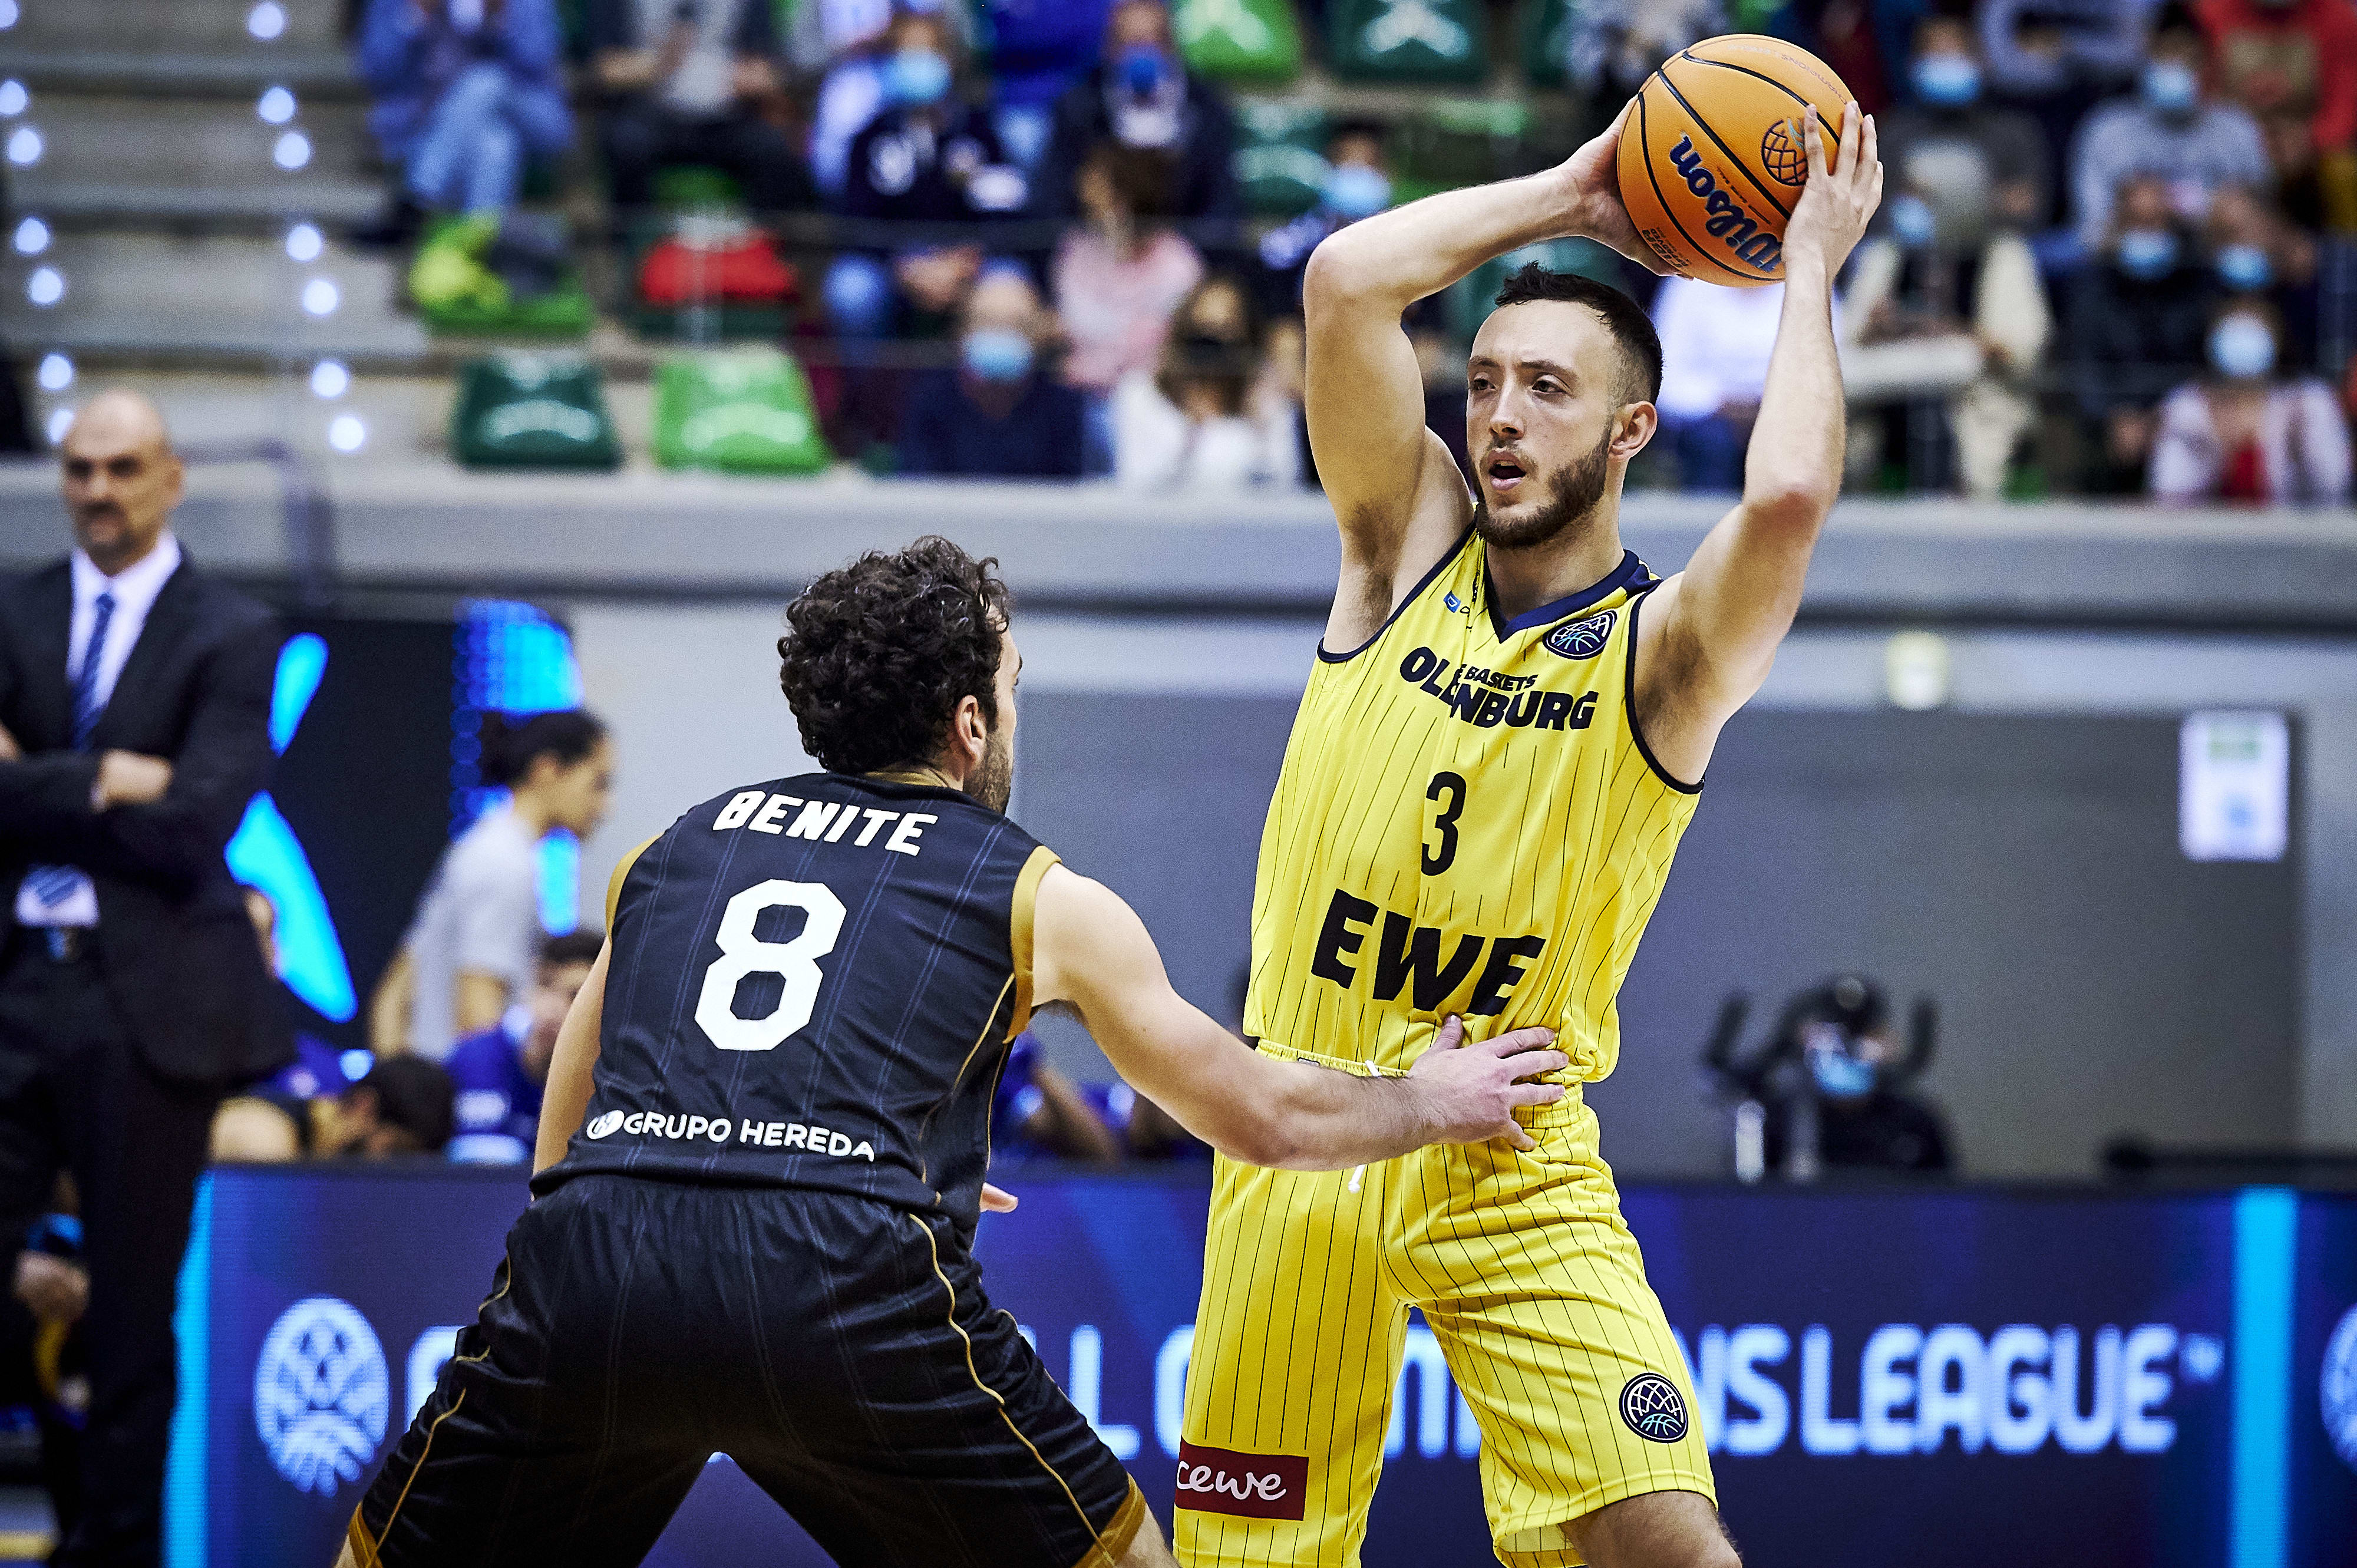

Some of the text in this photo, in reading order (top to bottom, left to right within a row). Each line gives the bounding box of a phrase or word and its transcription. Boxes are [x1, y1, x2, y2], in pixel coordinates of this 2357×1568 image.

[1669, 132, 1782, 272] Wilson
[1642, 229, 1683, 268] FIBA
[1650, 228, 1689, 267] APPROVED
[1399, 646, 1599, 731] OLNBURG
[712, 790, 938, 856] BENITE
[1421, 771, 1467, 876] 3
[694, 879, 847, 1051] 8
[1311, 888, 1546, 1015] EWE
[623, 1111, 875, 1162] GRUPO HEREDA
[1799, 1322, 2178, 1457] LEAGUE
[1176, 1460, 1286, 1501] cewe
